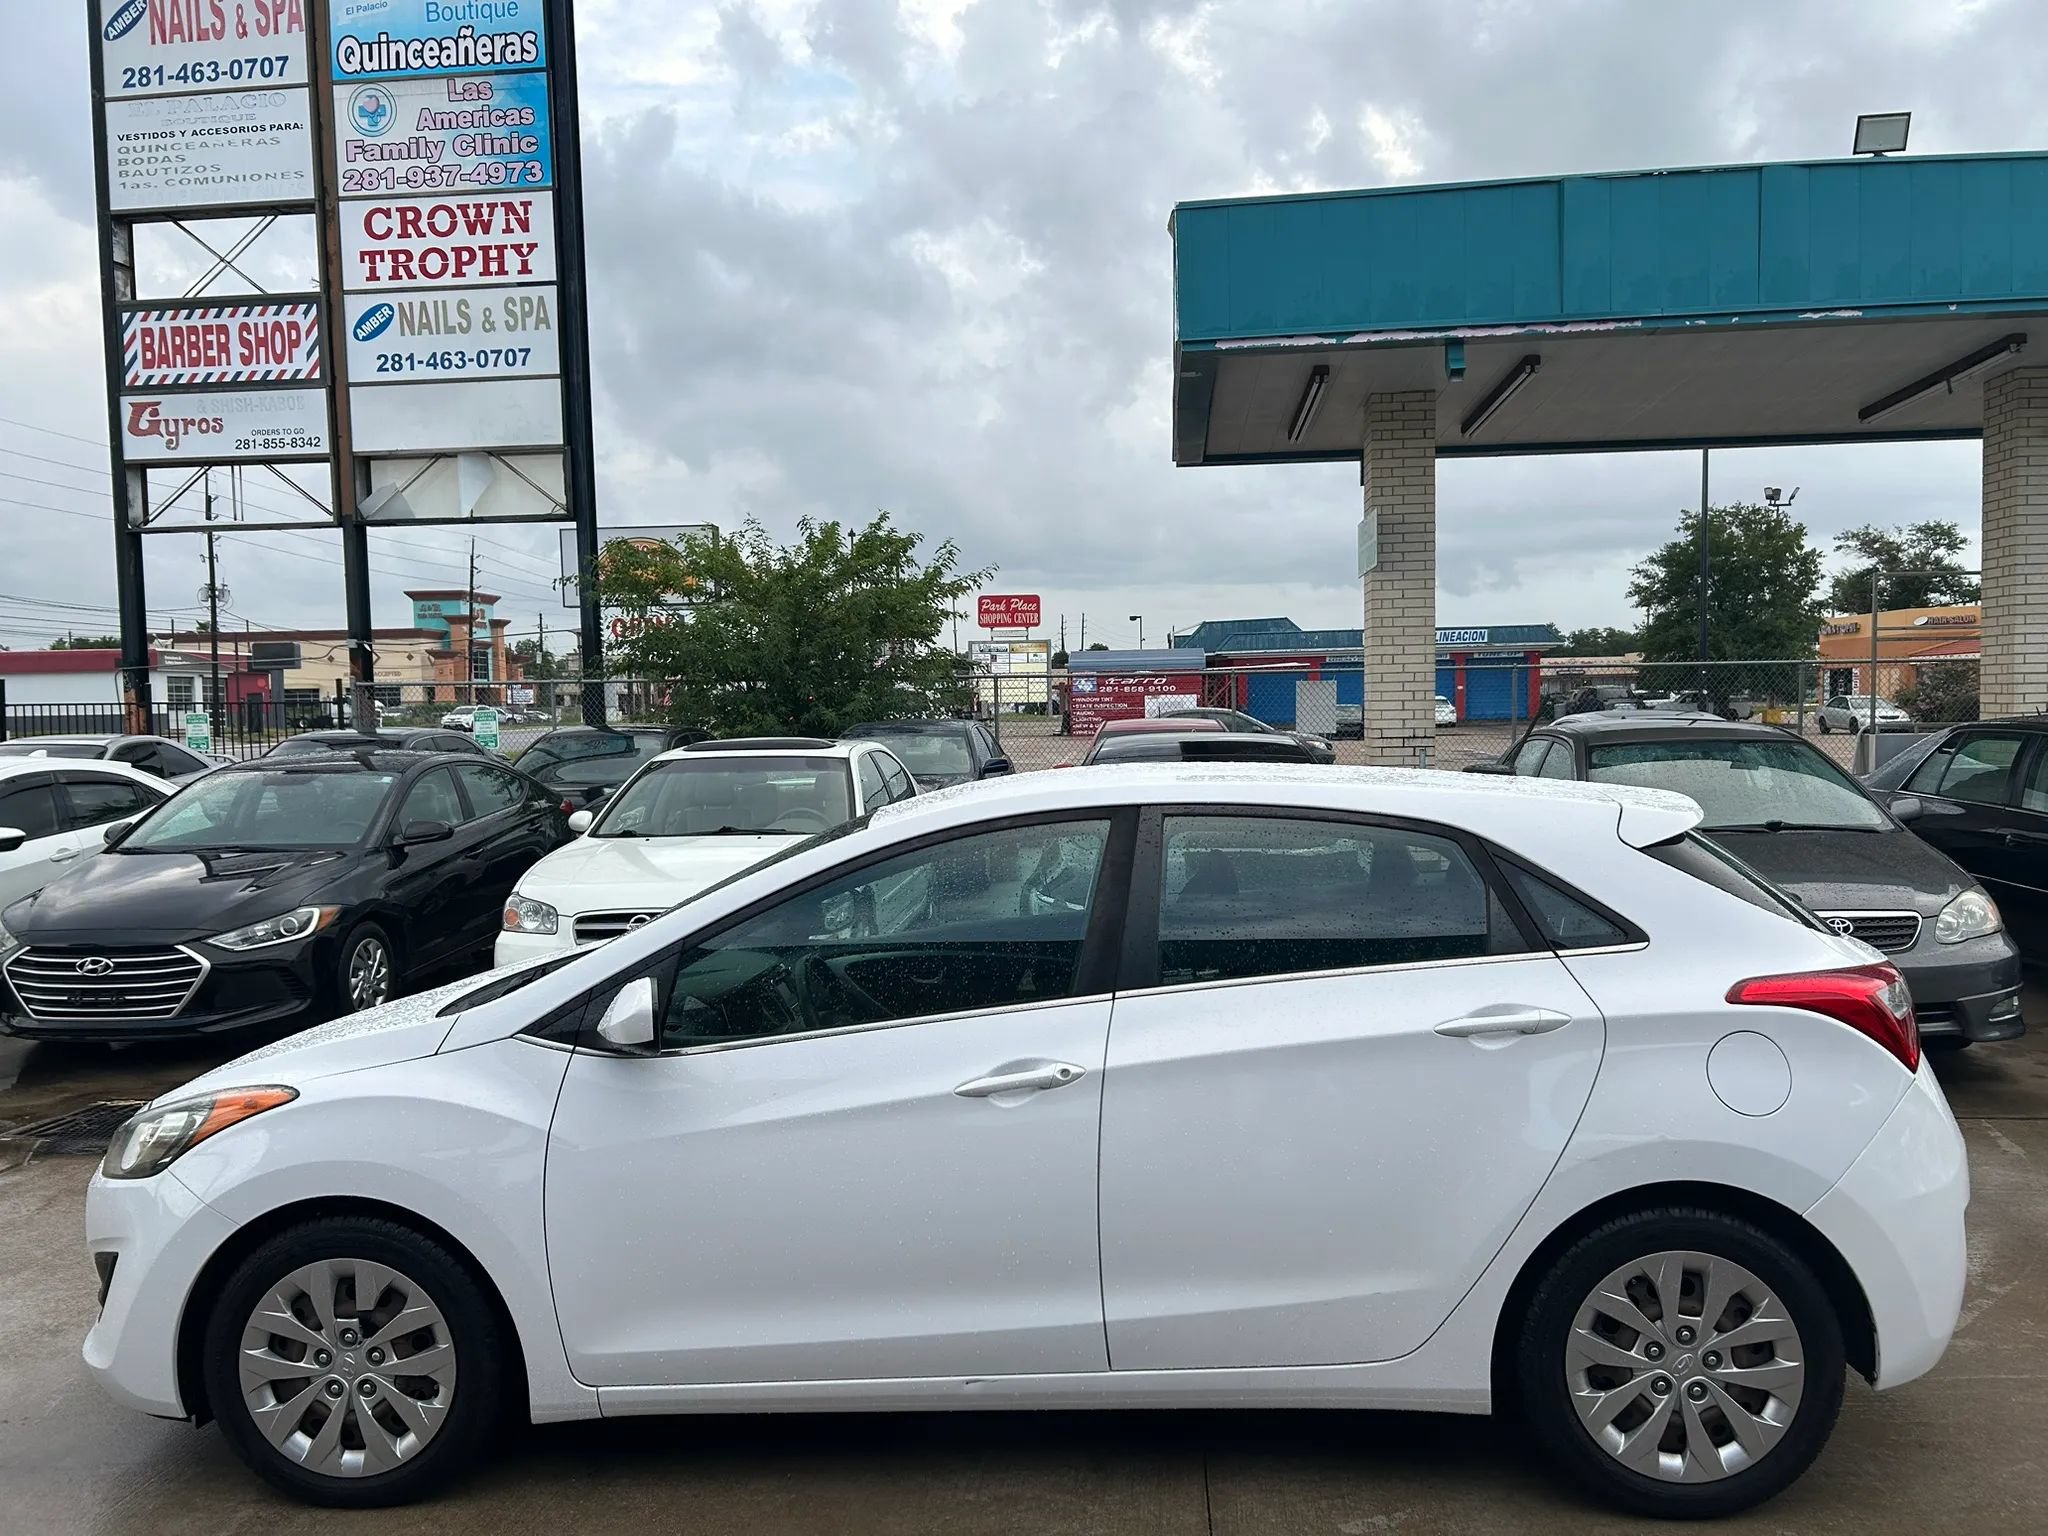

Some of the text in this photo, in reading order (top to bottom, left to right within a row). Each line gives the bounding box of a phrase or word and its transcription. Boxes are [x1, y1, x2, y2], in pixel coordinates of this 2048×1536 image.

[356, 1, 388, 13] Palacio
[426, 0, 519, 24] Boutique
[106, 0, 147, 40] AMBER
[149, 0, 304, 45] NAILS & SPA
[337, 25, 538, 74] Quinceañeras
[122, 56, 289, 88] 281-463-0707
[167, 92, 288, 114] PALACIO
[447, 79, 493, 102] Las
[416, 105, 535, 131] Americas
[117, 122, 304, 142] VESTIDOS Y ACCESORIOS PARA:
[346, 132, 539, 163] Family Clinic
[117, 154, 186, 167] BODAS
[118, 164, 221, 178] BAUTIZOS
[119, 170, 305, 191] 1as. COMUNIONES
[343, 160, 543, 191] 281-937-4973
[363, 201, 532, 241] CROWN
[359, 242, 538, 282] TROPHY
[355, 305, 394, 340] AMBER
[397, 295, 551, 337] NAILS & SPA
[140, 320, 300, 370] BARBER SHOP
[376, 348, 531, 372] 281-463-0707
[128, 401, 224, 450] Gyros
[251, 428, 281, 436] ORDERS
[293, 427, 304, 435] GO
[235, 436, 321, 450] 281-855-8342
[981, 598, 1037, 612] Park Place
[979, 612, 1039, 625] SHOPPING CENTER
